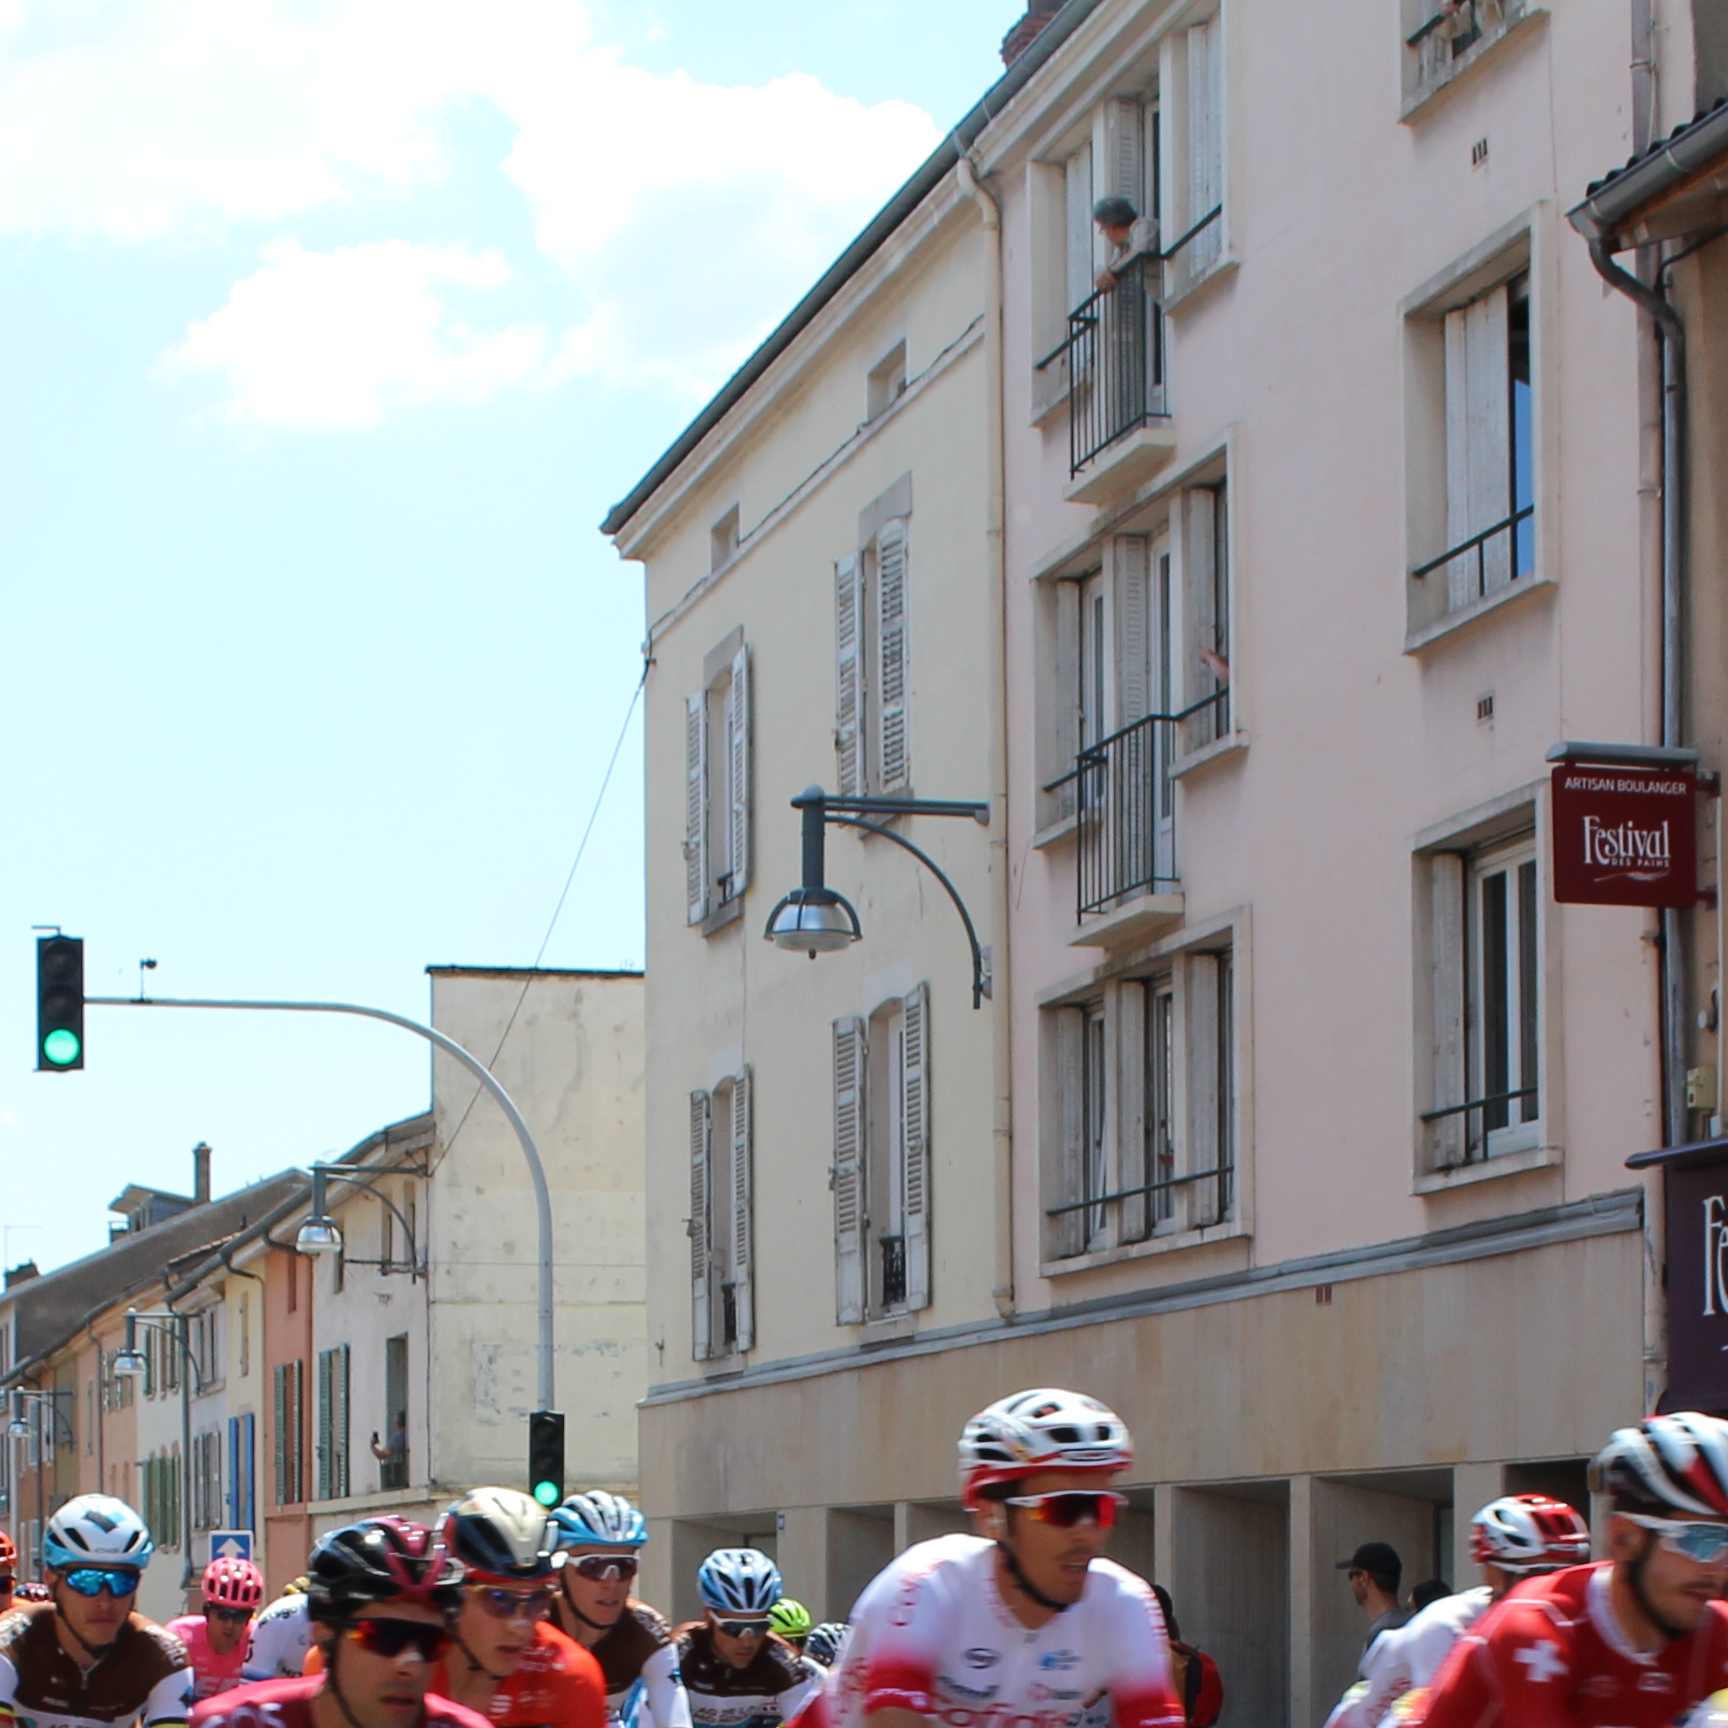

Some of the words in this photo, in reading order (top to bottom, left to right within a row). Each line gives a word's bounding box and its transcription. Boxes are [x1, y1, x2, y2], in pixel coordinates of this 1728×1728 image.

[1565, 777, 1614, 792] ARTISAN
[1617, 780, 1687, 795] BOULANGER
[1583, 815, 1671, 866] Festival
[1611, 857, 1631, 866] DES
[1637, 858, 1670, 868] PAINS
